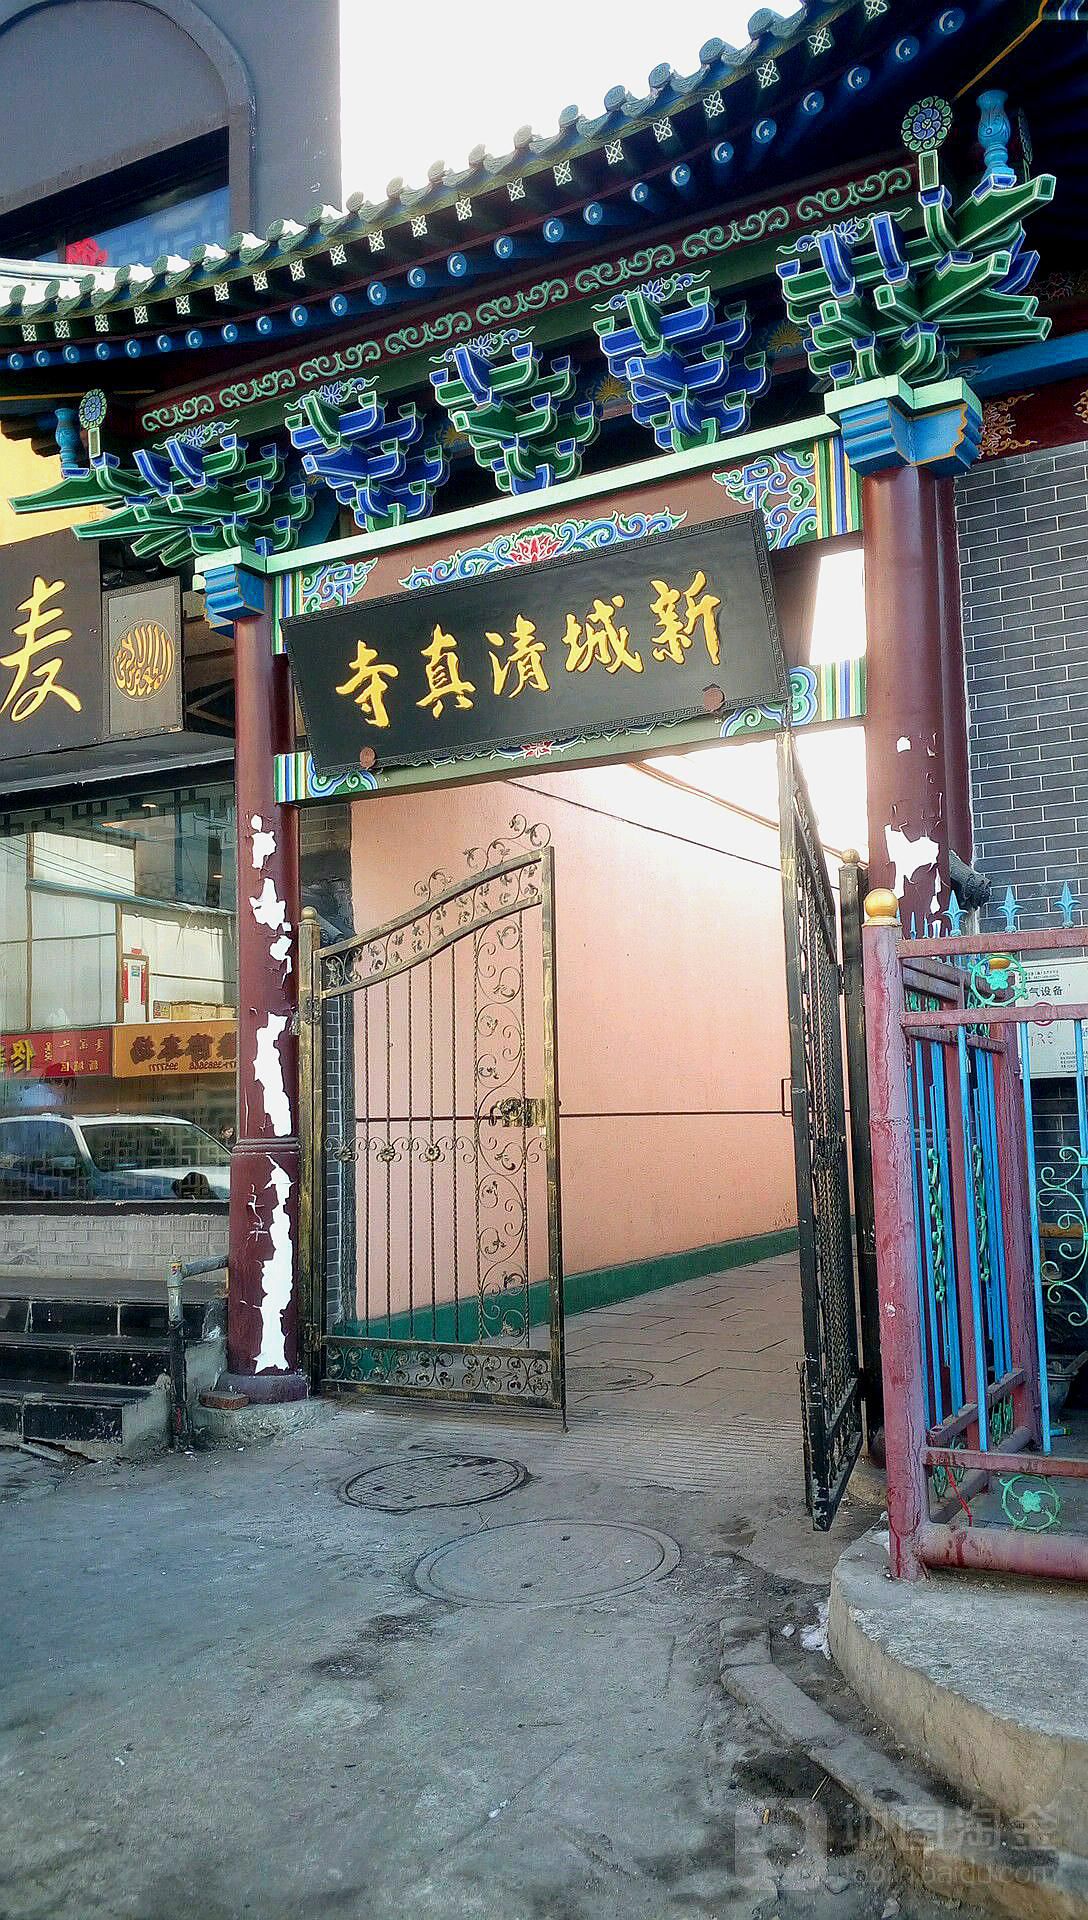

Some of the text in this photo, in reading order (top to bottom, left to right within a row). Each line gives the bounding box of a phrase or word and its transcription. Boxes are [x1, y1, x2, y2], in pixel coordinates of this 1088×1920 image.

[335, 570, 721, 728] 新城清真寺
[1023, 985, 1063, 997] 气设备
